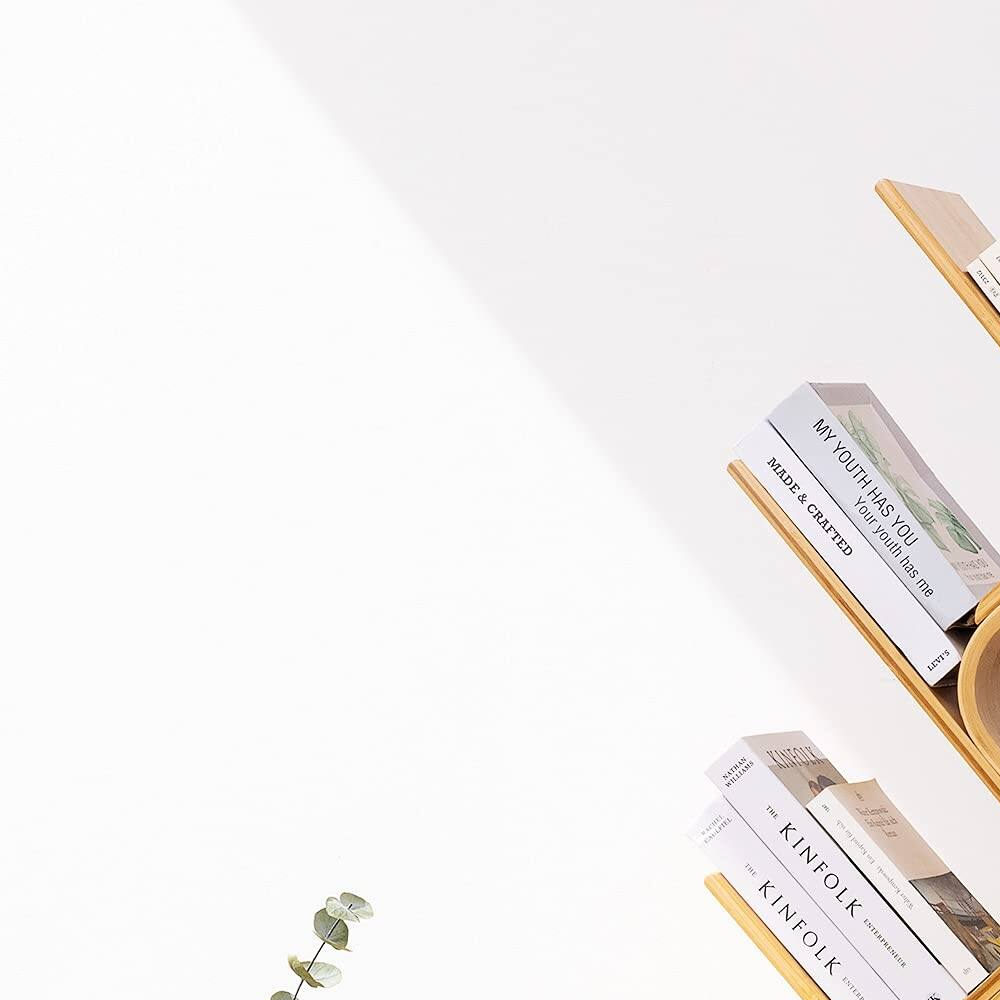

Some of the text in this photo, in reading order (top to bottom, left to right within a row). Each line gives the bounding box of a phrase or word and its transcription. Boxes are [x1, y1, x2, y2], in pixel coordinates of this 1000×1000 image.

[812, 418, 919, 548] MY YOUTH HAS YOU
[767, 456, 853, 557] MADE & CRAFTED
[854, 496, 934, 598] Your youth has me
[927, 649, 950, 672] LEVI'S
[722, 756, 748, 781] NATHAN
[766, 745, 825, 769] KINFOLK
[725, 760, 754, 788] WILLIAMS
[701, 814, 725, 837] RACHEL
[765, 805, 779, 820] THE
[779, 822, 863, 918] KINFOLK
[898, 891, 915, 909] Walter
[744, 863, 758, 877] THE
[758, 880, 841, 976] KINFOLK
